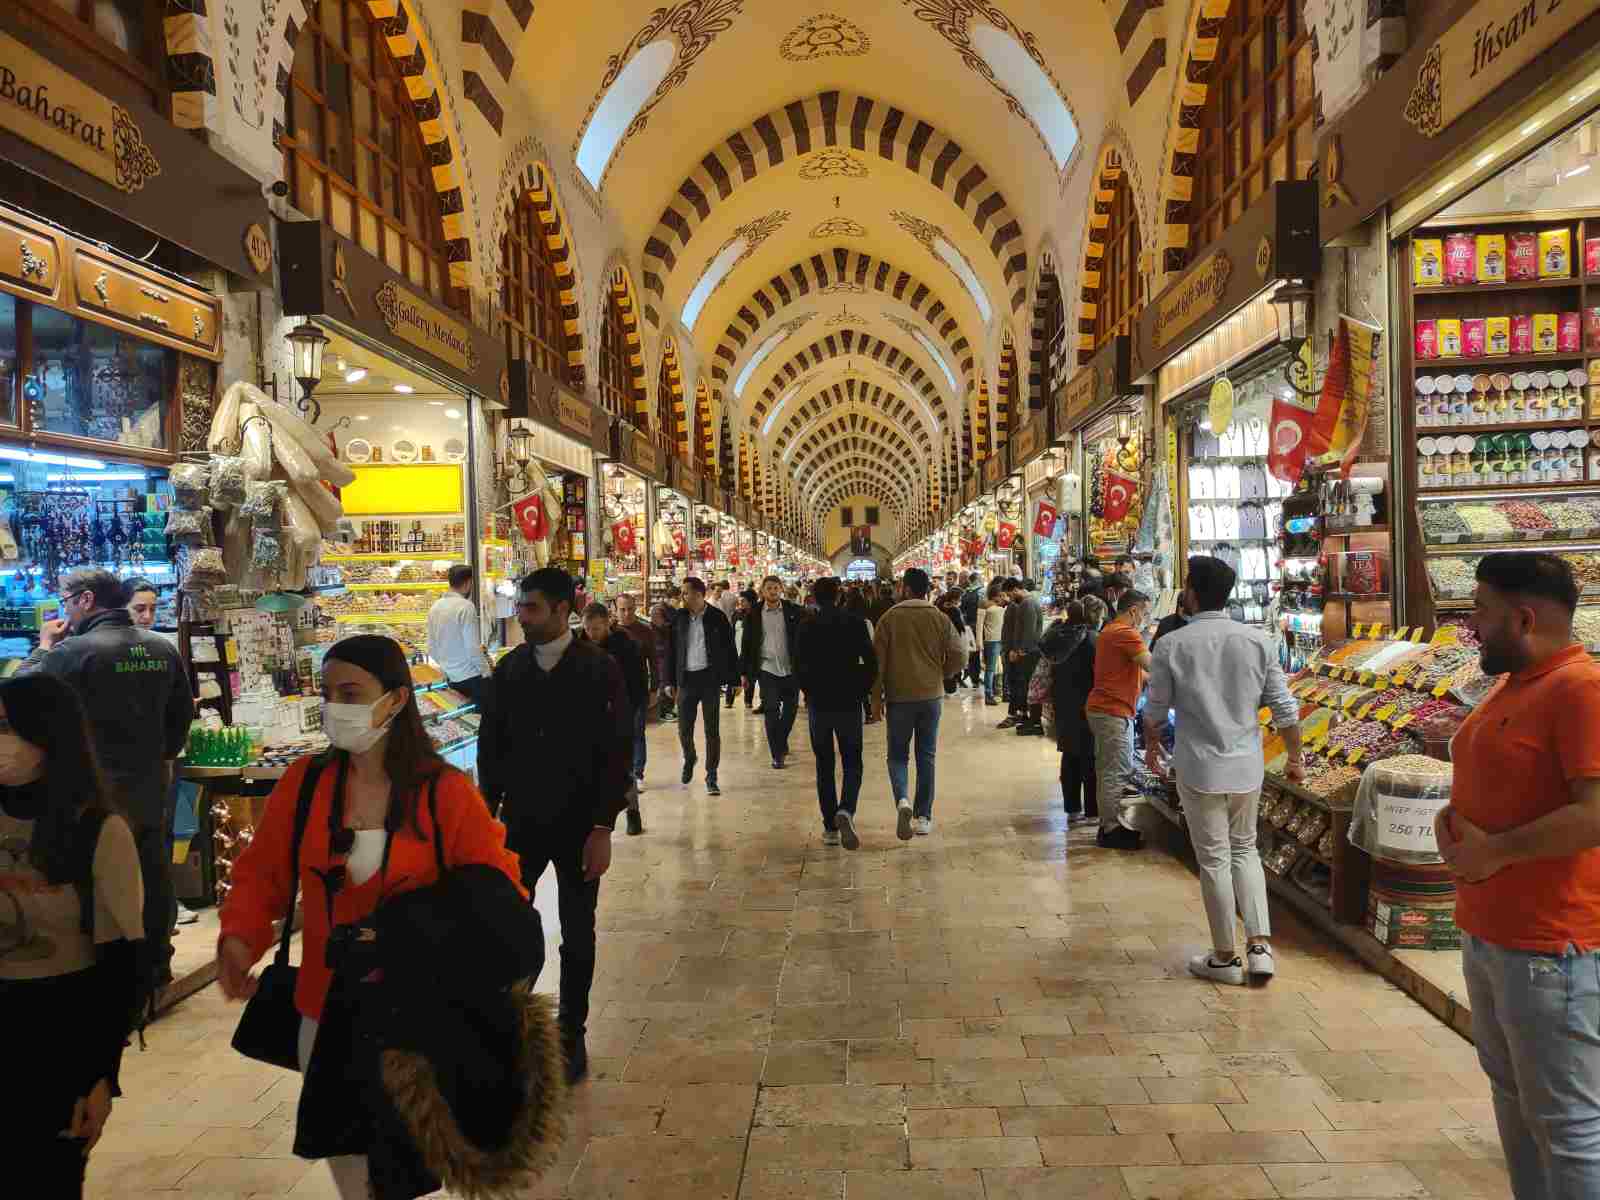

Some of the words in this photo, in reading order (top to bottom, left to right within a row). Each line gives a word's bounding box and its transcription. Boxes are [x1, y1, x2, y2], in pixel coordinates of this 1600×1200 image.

[0, 66, 106, 151] Baharat
[399, 302, 430, 338] Gallery
[1352, 560, 1373, 569] TEA
[115, 659, 169, 673] BAHARAT
[1388, 823, 1414, 836] 250
[1416, 825, 1434, 839] TL
